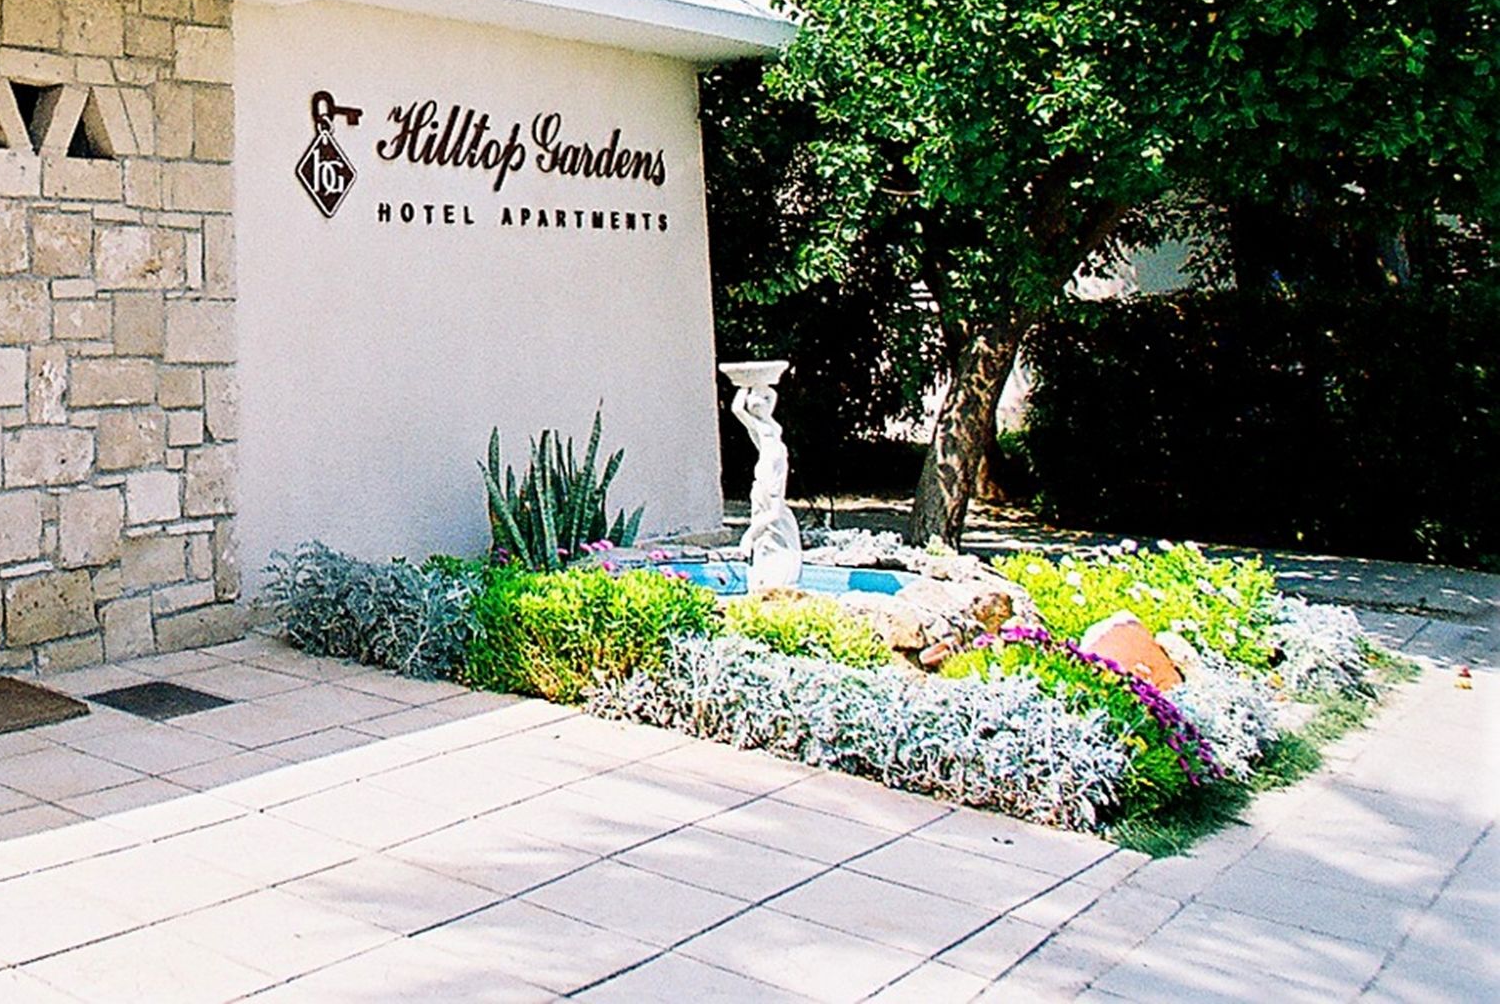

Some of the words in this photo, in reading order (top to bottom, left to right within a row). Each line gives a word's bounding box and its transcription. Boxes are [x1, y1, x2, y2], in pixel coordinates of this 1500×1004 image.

[377, 100, 526, 192] Hilltop
[531, 112, 666, 186] Gardens
[378, 202, 475, 225] HOTEL
[501, 207, 668, 232] APARTMENTS
